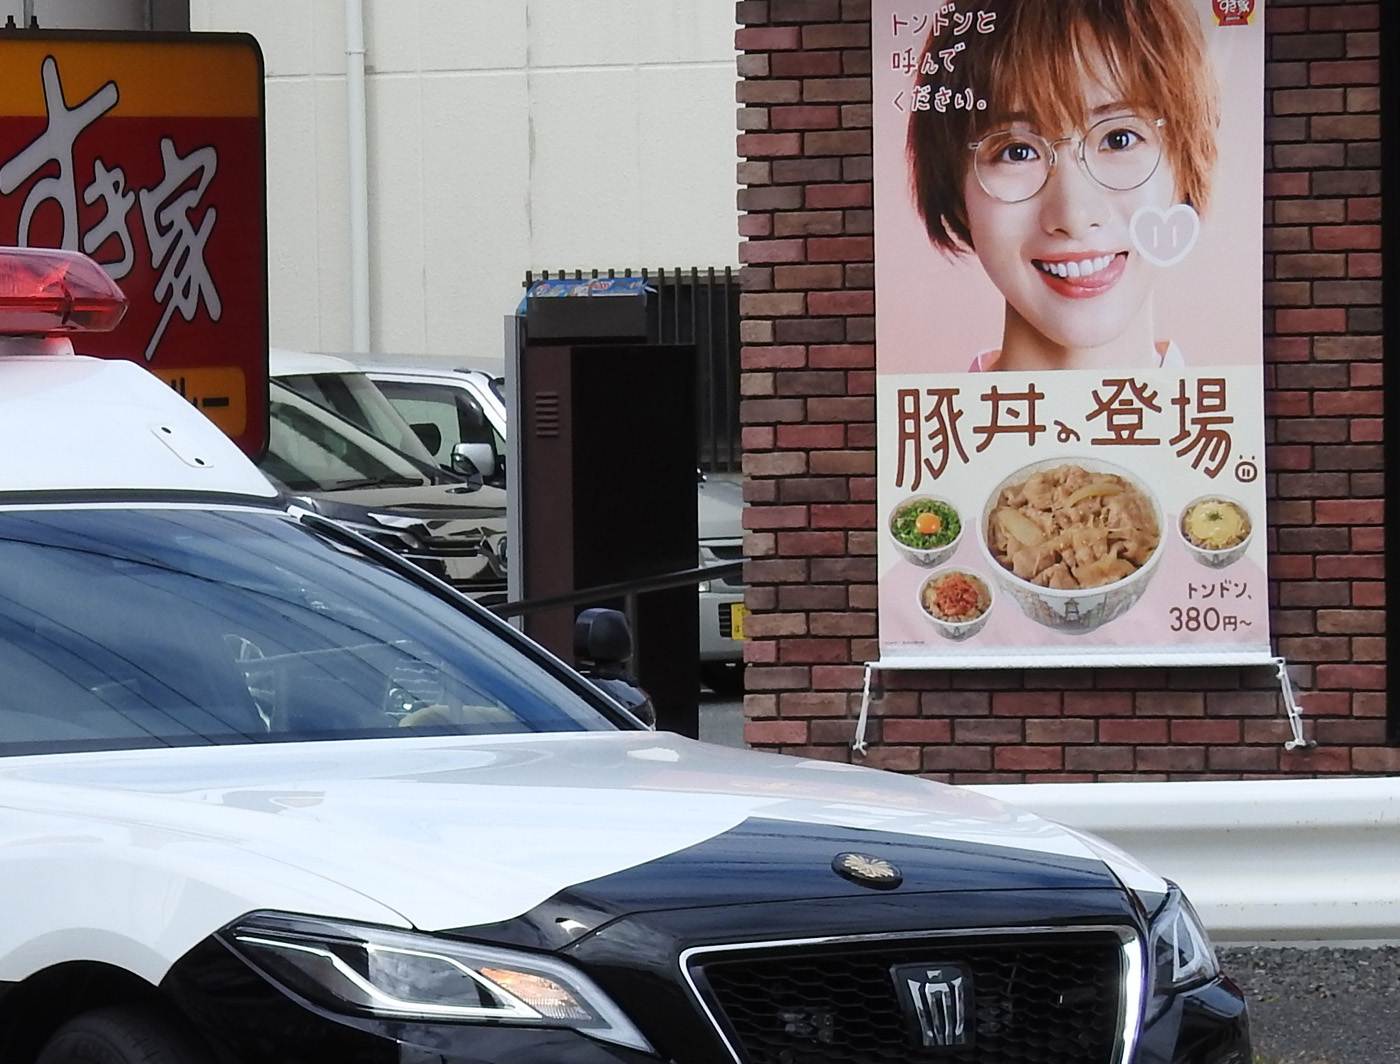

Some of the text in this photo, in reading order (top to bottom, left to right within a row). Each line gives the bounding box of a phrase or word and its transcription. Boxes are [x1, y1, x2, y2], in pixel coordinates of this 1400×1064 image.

[892, 3, 996, 36] トンドンと
[892, 42, 966, 75] 呼んで
[892, 85, 987, 112] ください。
